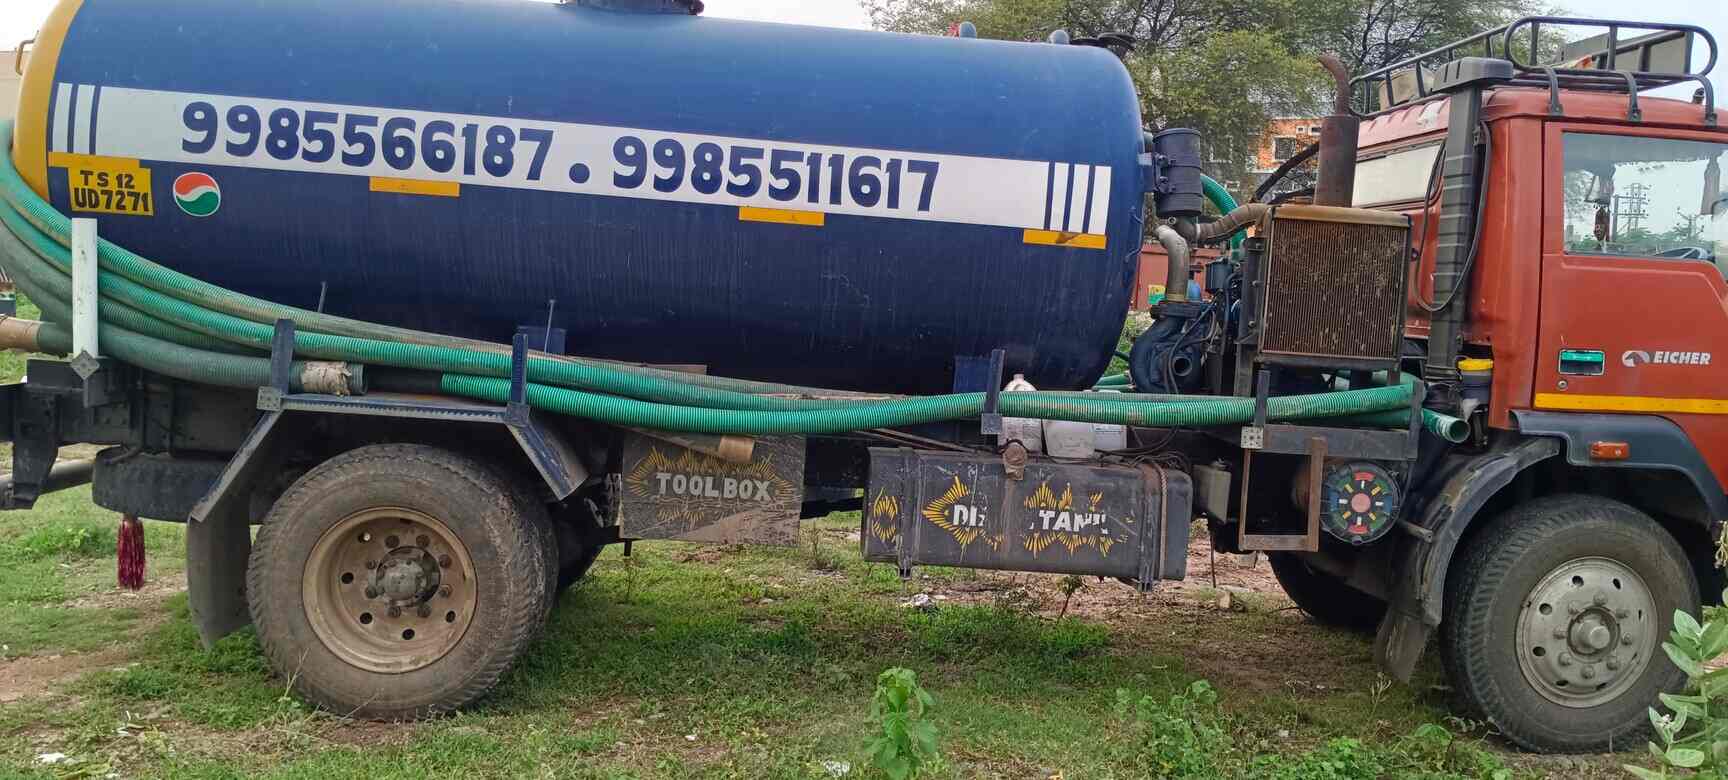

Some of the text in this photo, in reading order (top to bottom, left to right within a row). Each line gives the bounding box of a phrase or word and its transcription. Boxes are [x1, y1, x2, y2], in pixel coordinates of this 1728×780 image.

[182, 101, 940, 212] 9985566187 9985511617
[116, 173, 135, 189] 12
[74, 187, 149, 211] UD7271
[1653, 351, 1711, 365] EICHER
